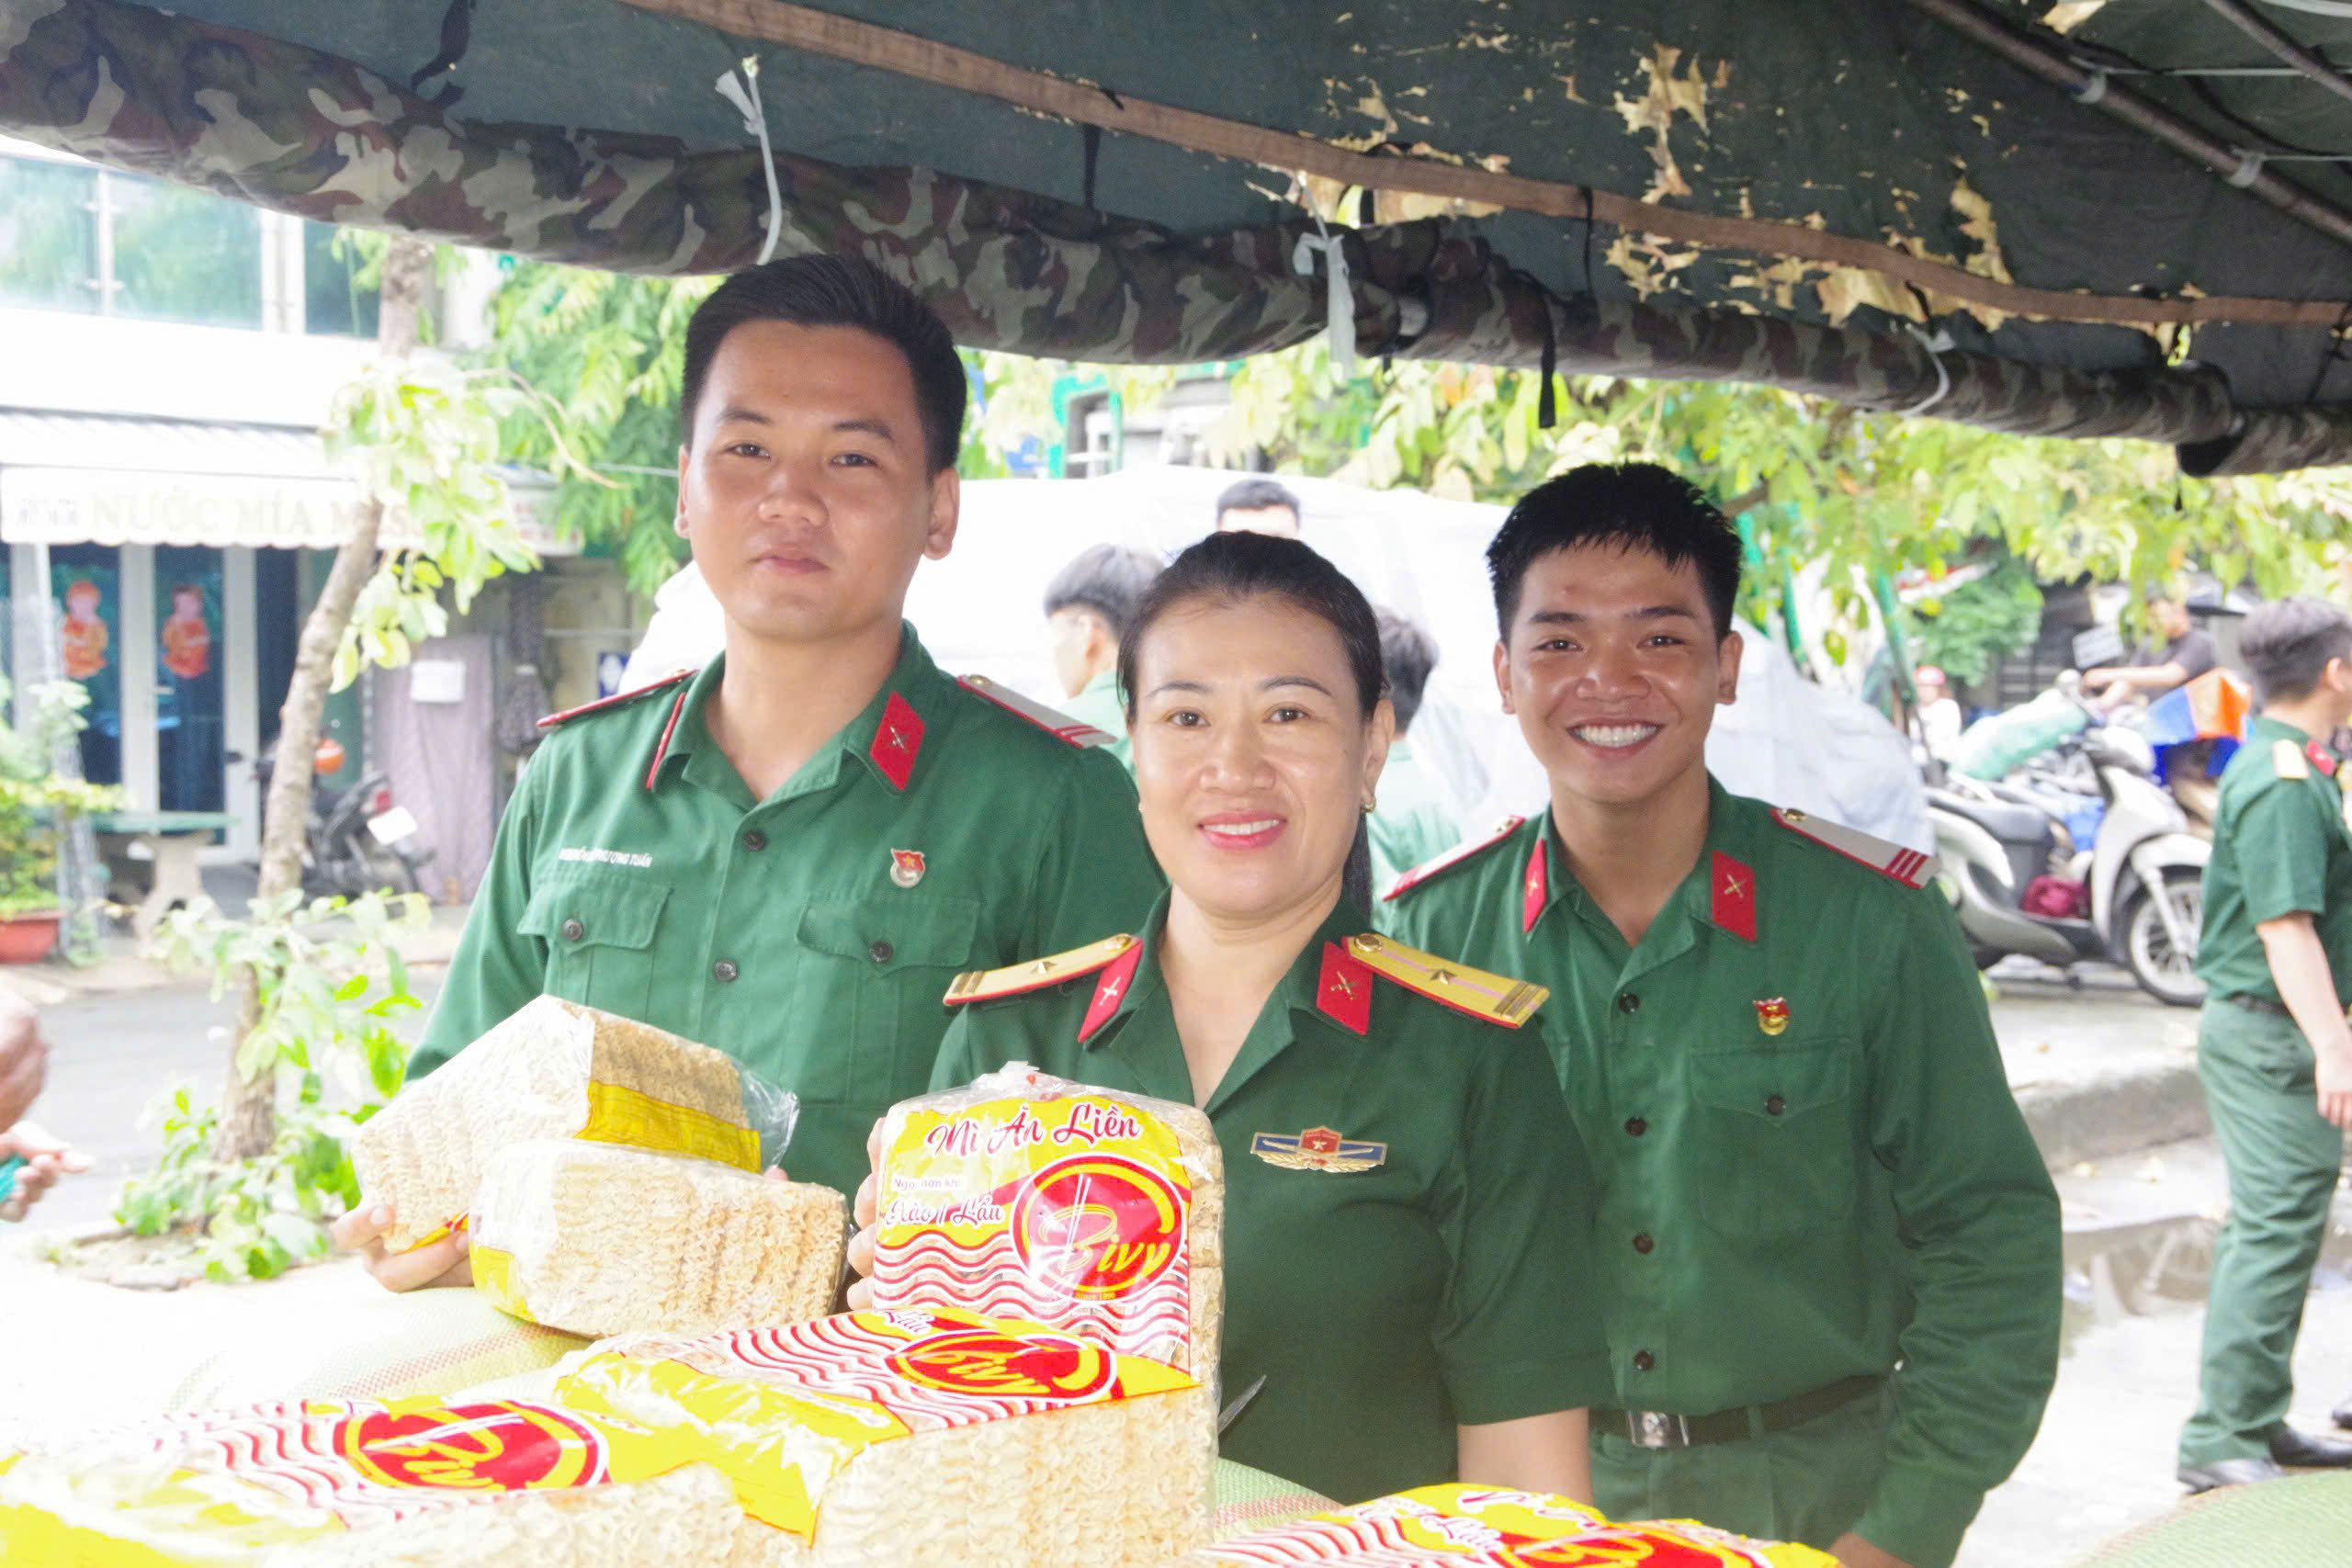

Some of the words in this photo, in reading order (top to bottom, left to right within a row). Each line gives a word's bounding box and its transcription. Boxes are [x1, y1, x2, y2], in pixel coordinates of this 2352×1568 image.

[926, 1119, 979, 1157] Mì
[987, 1105, 1044, 1155] Ăn
[1052, 1103, 1140, 1145] Liền
